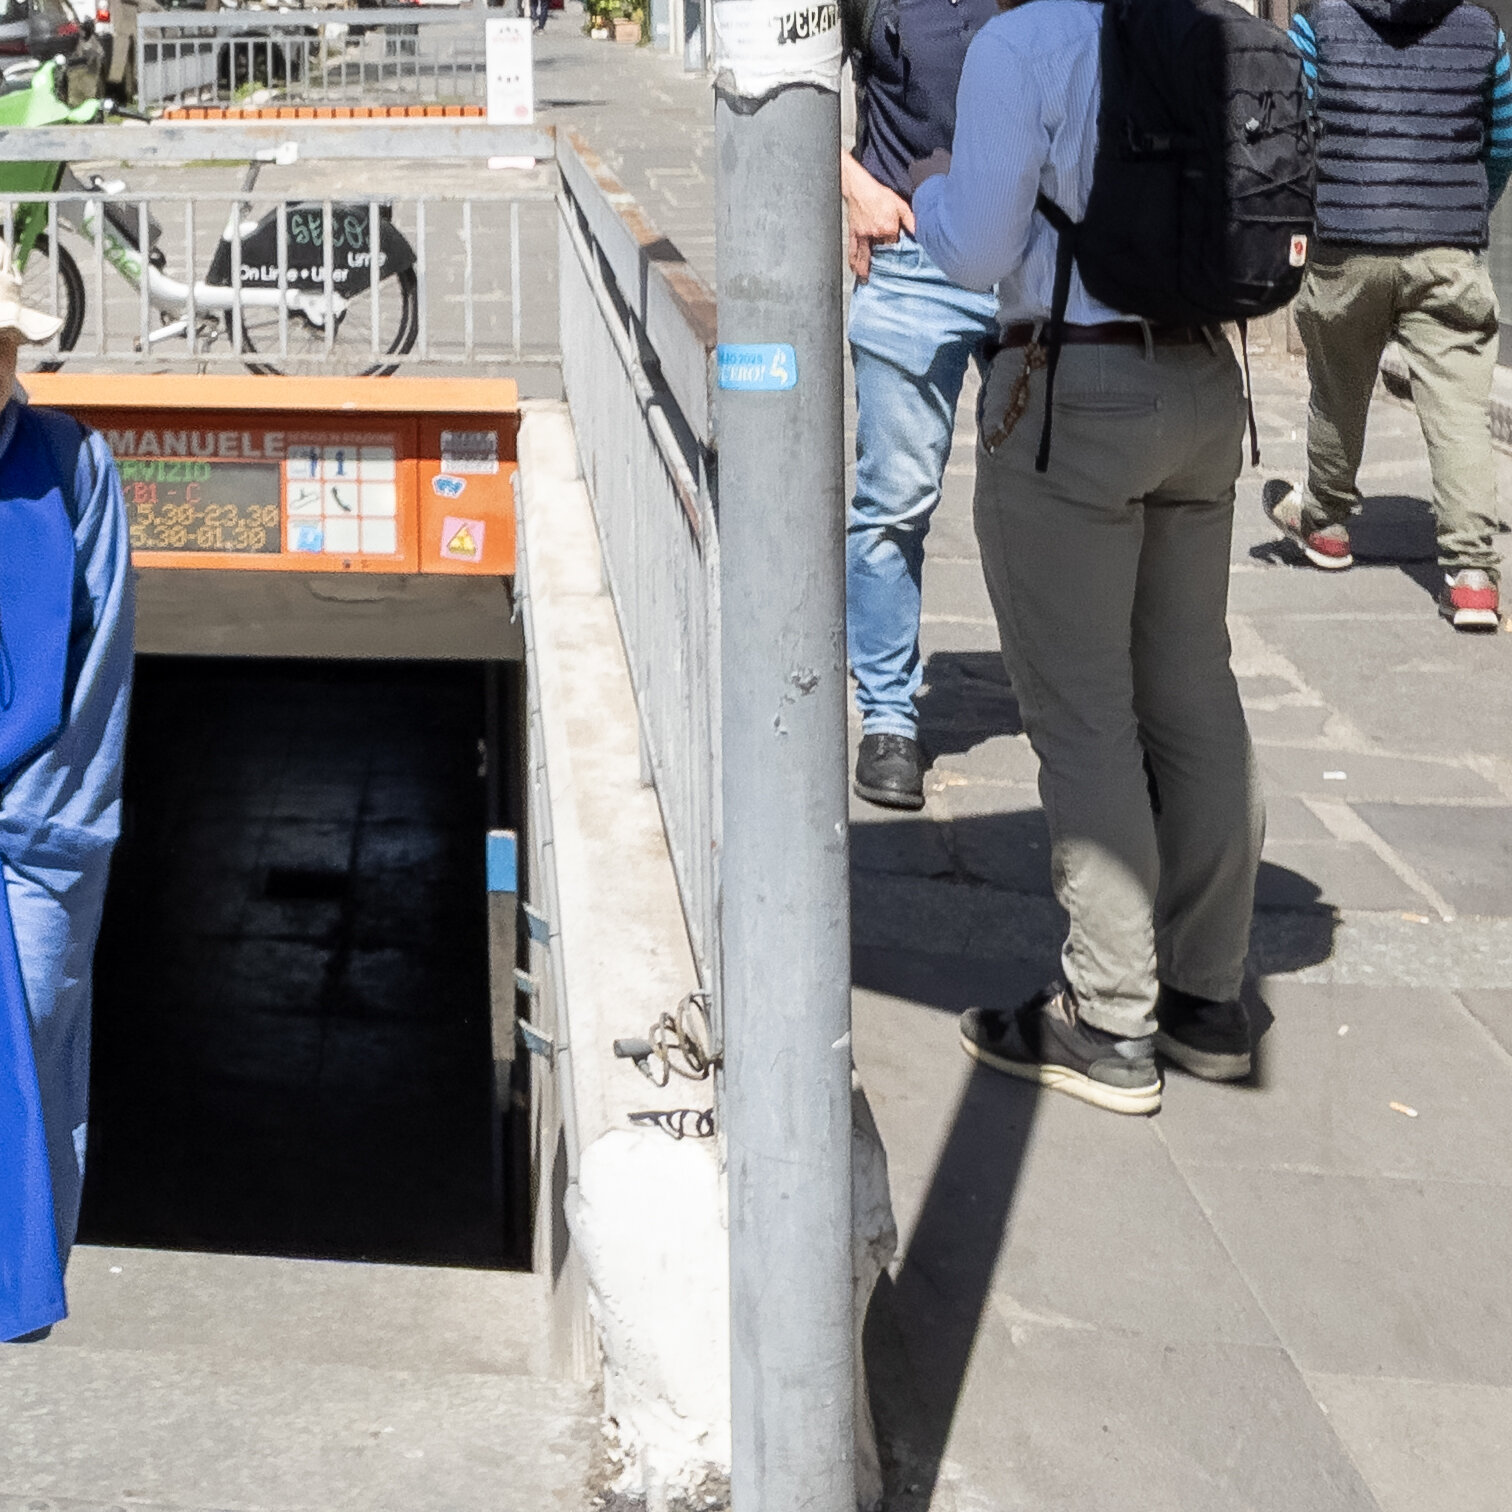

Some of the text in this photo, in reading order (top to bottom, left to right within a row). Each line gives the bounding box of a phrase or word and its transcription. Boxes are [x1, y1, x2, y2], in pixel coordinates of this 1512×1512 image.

[311, 265, 349, 283] Uer
[186, 481, 201, 504] C
[137, 502, 280, 528] 5.30-23.30
